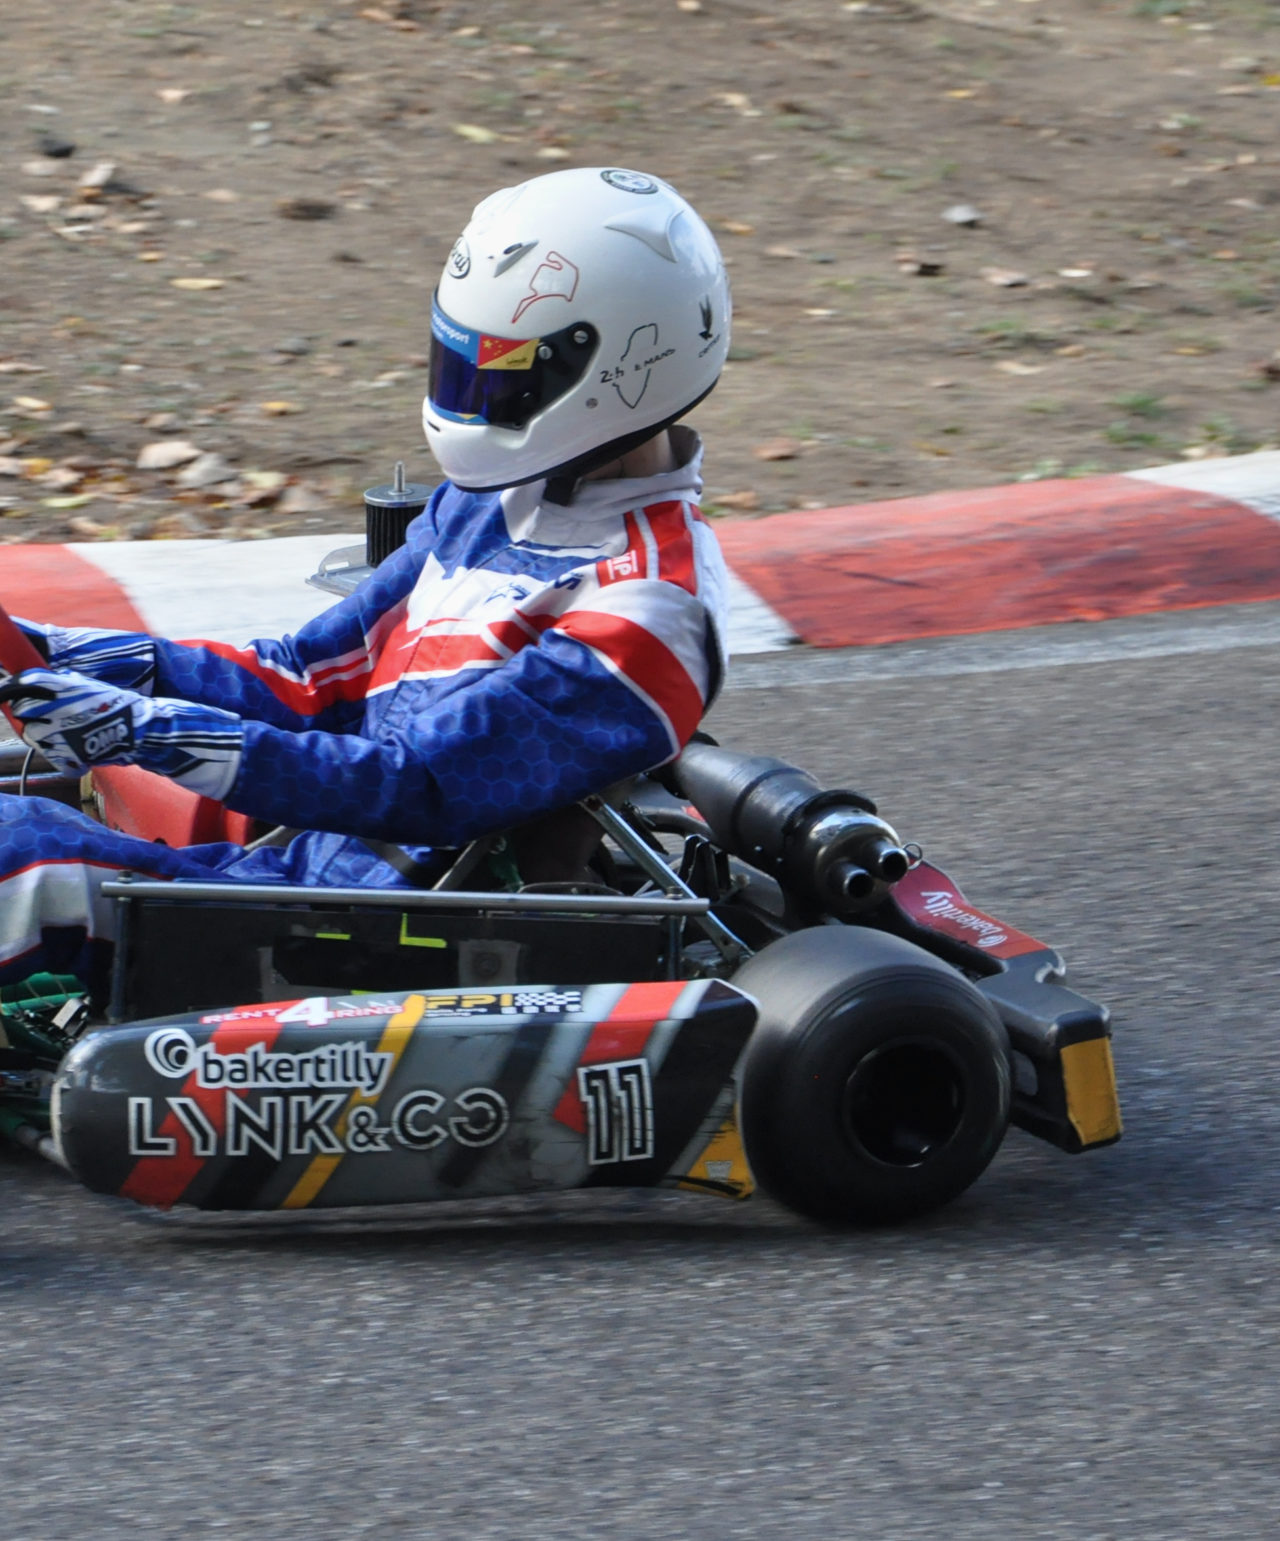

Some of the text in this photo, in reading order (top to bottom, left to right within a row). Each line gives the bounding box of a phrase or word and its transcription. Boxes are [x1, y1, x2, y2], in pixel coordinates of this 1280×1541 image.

[276, 997, 333, 1027] 4
[426, 993, 513, 1008] FPI
[200, 1045, 388, 1091] bakertilly
[577, 1058, 653, 1165] 11
